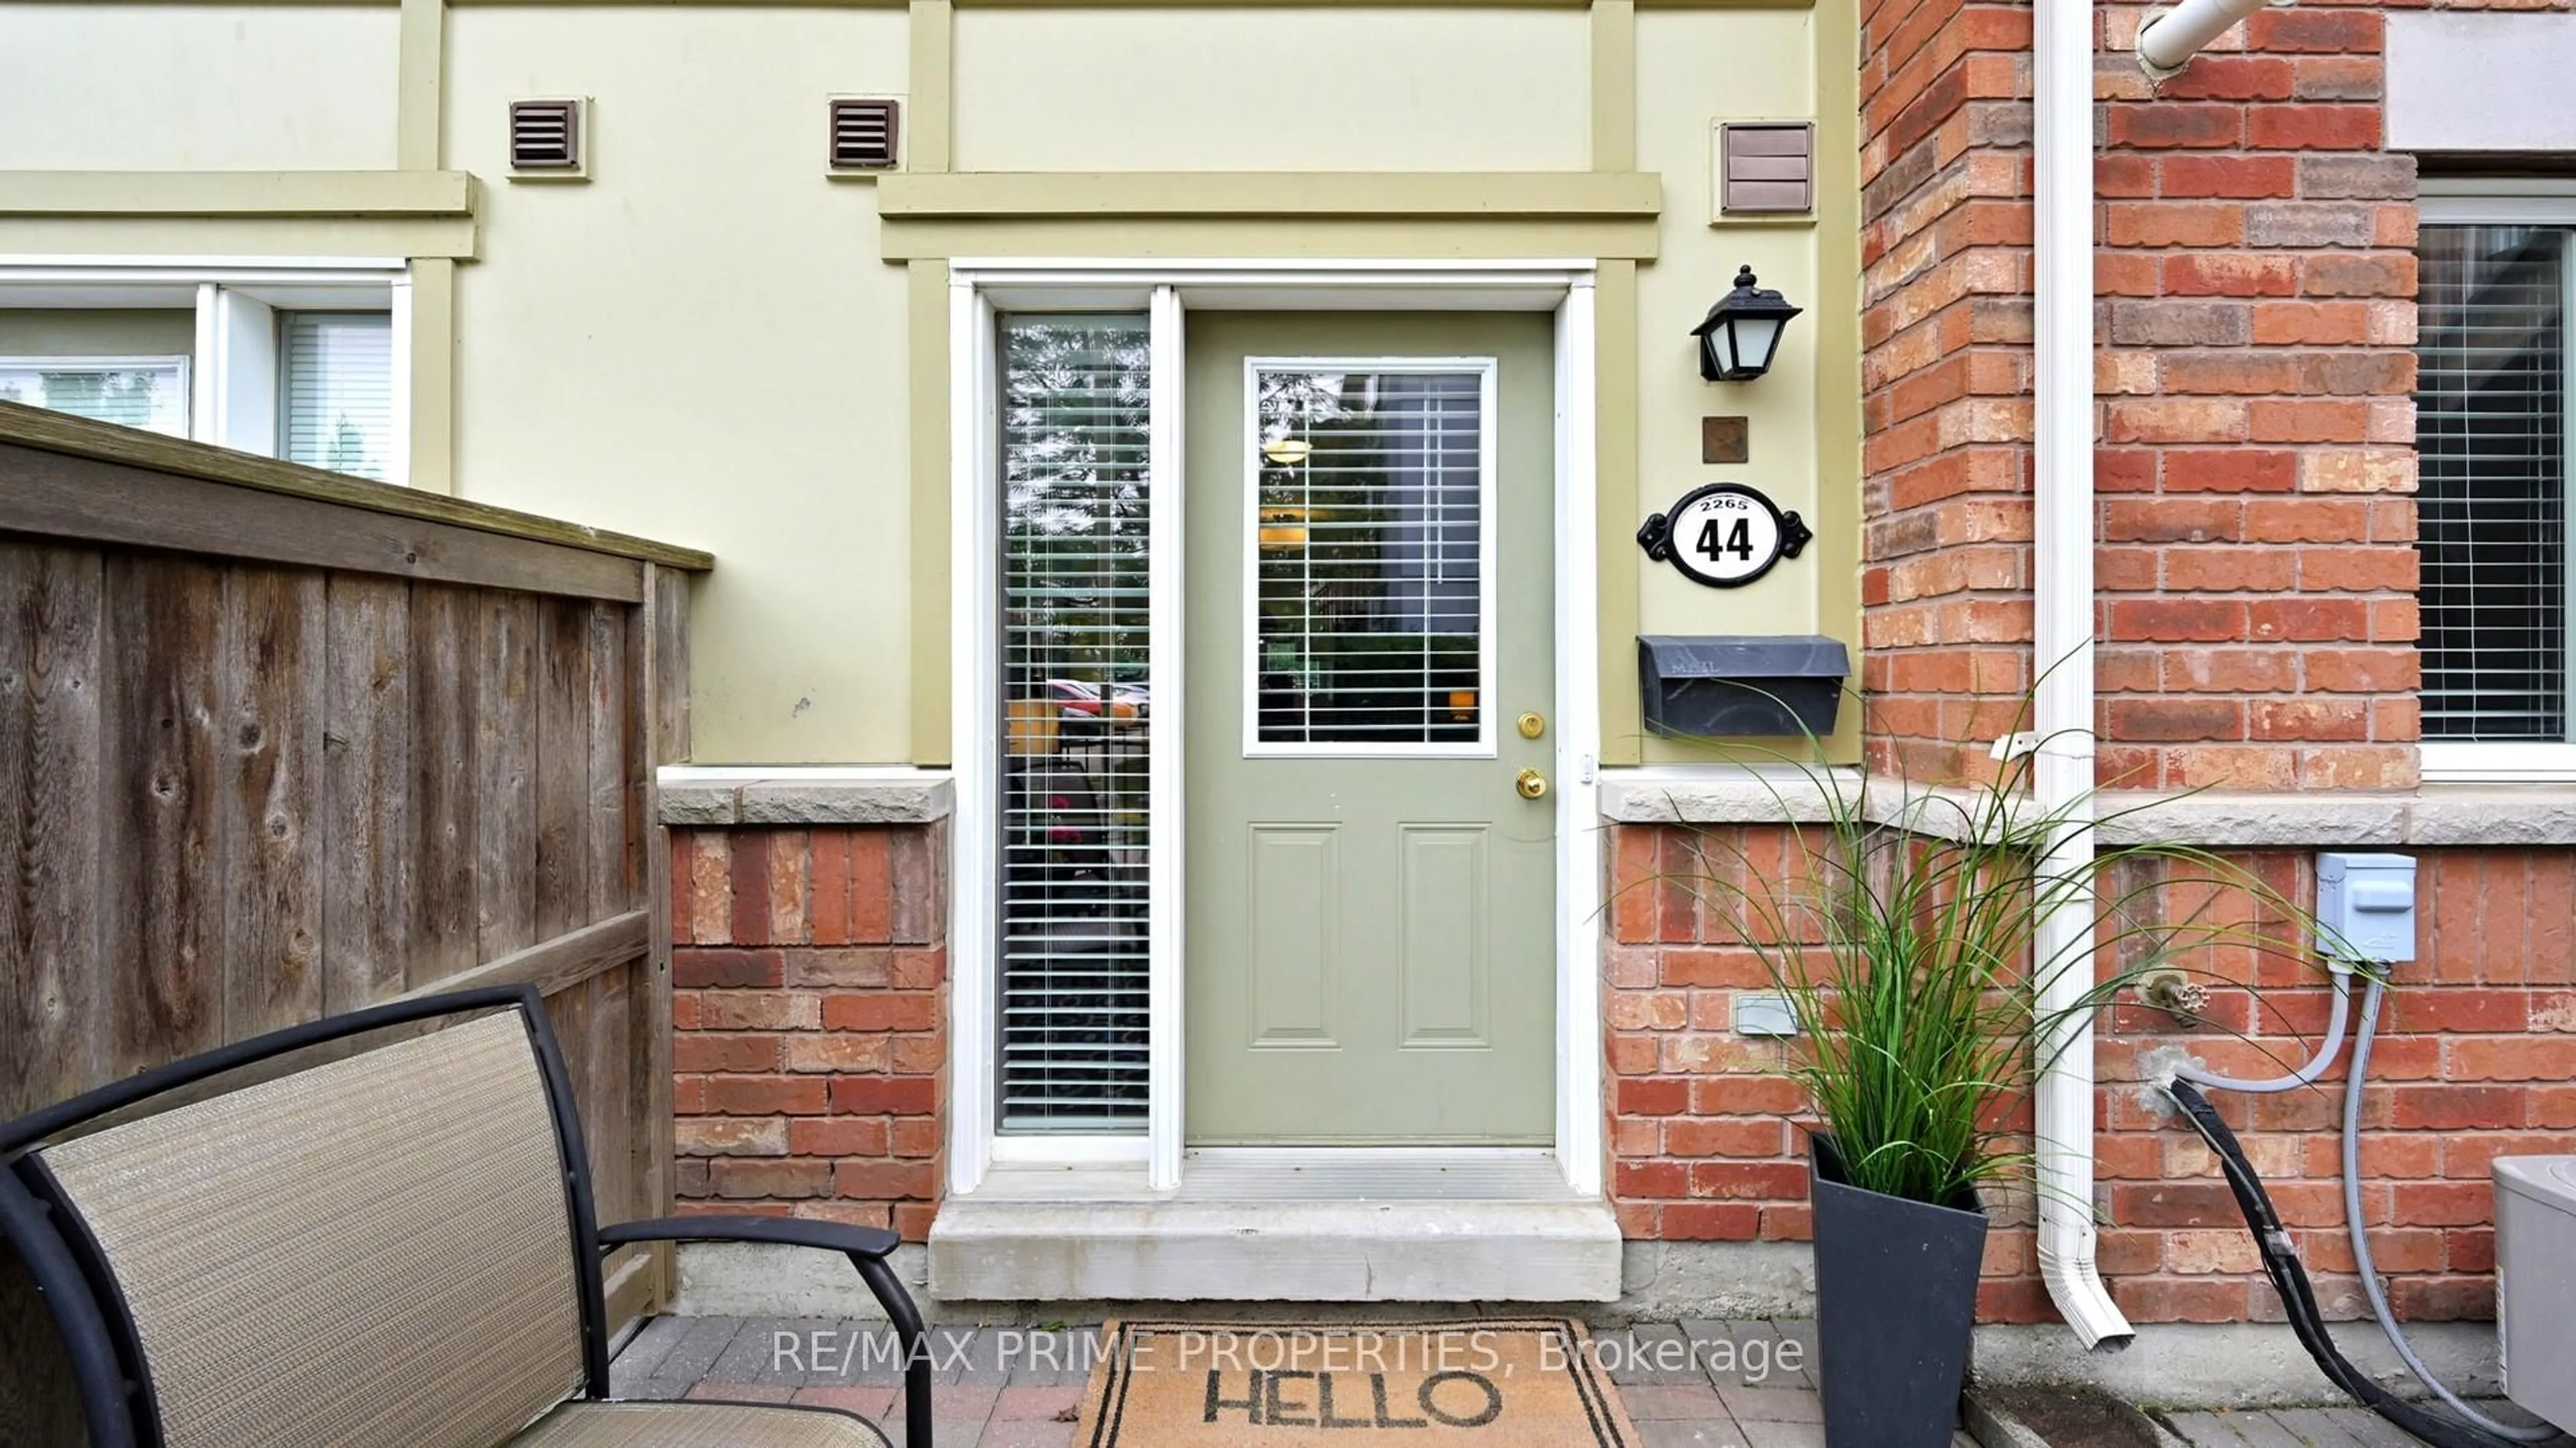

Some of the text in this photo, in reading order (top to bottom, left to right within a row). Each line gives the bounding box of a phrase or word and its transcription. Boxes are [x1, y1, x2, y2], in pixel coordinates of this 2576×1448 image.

[1700, 499, 1749, 512] 2265
[1696, 517, 1754, 562] 44
[1204, 1368, 1503, 1428] HELLO
